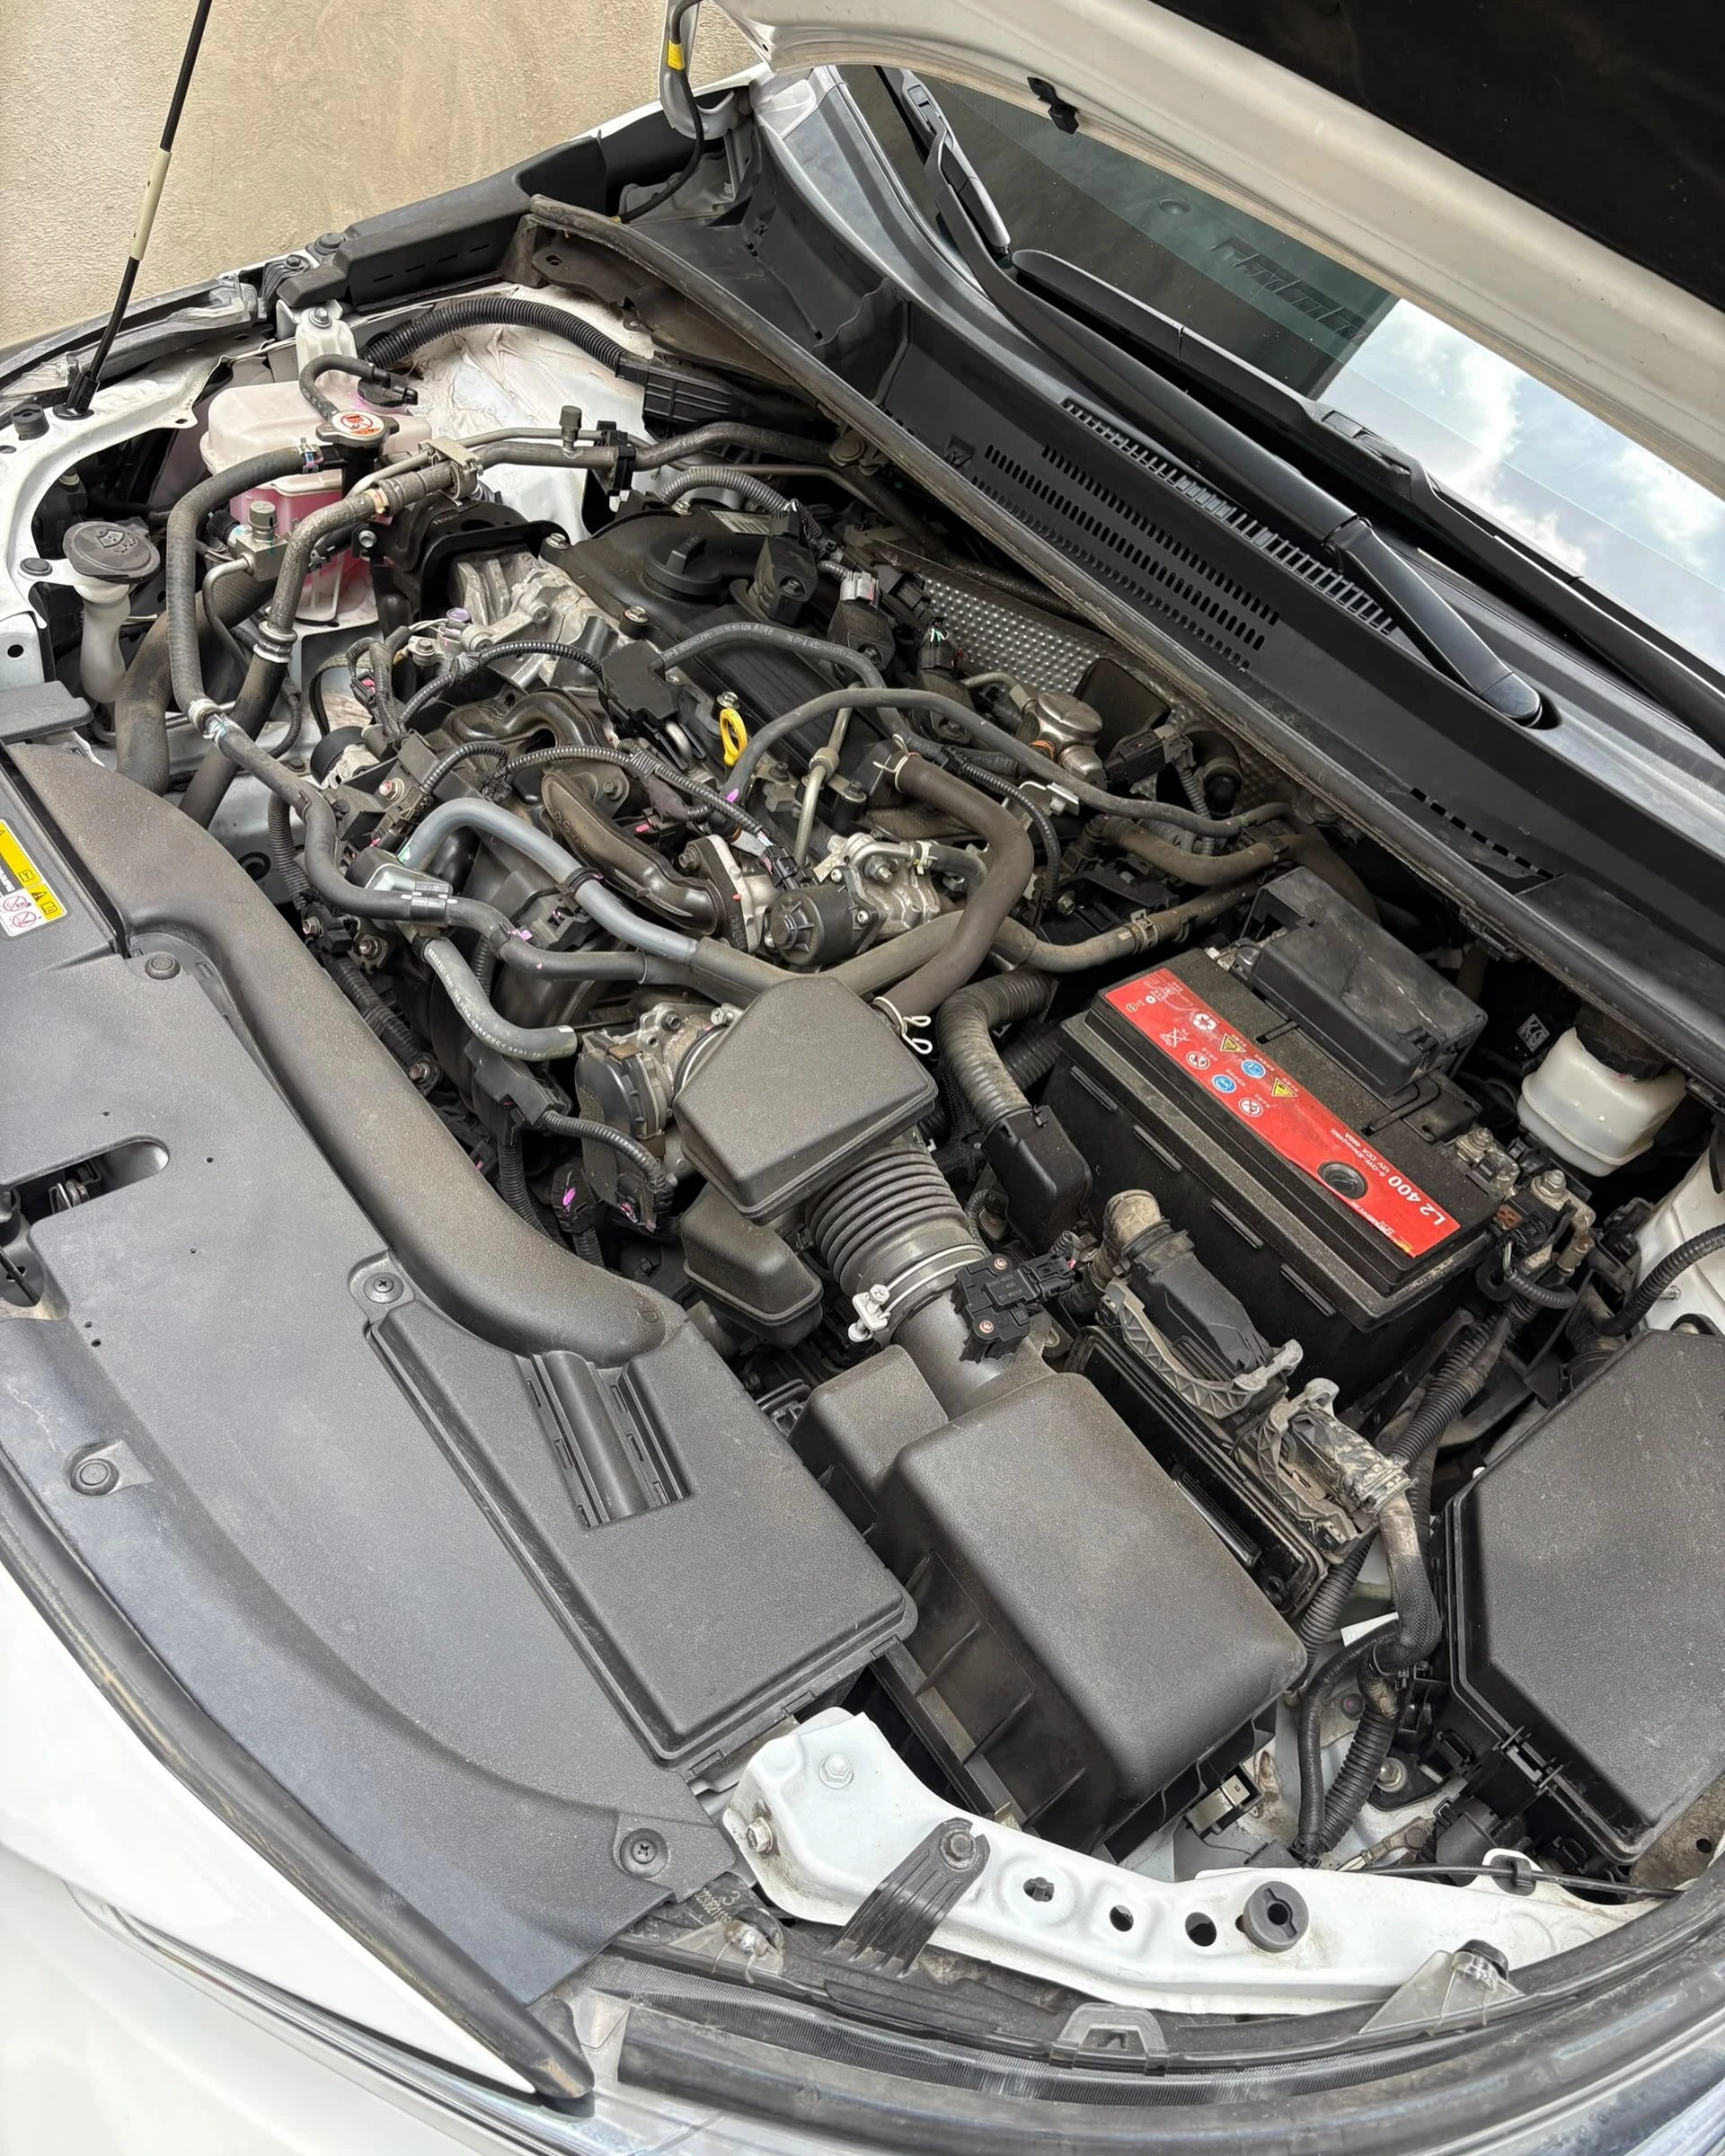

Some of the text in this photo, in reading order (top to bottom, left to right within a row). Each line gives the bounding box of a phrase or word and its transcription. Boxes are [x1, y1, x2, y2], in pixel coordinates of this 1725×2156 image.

[1362, 1147, 1377, 1162] CCA
[1387, 1175, 1422, 1203] 400
[1420, 1203, 1446, 1226] L2
